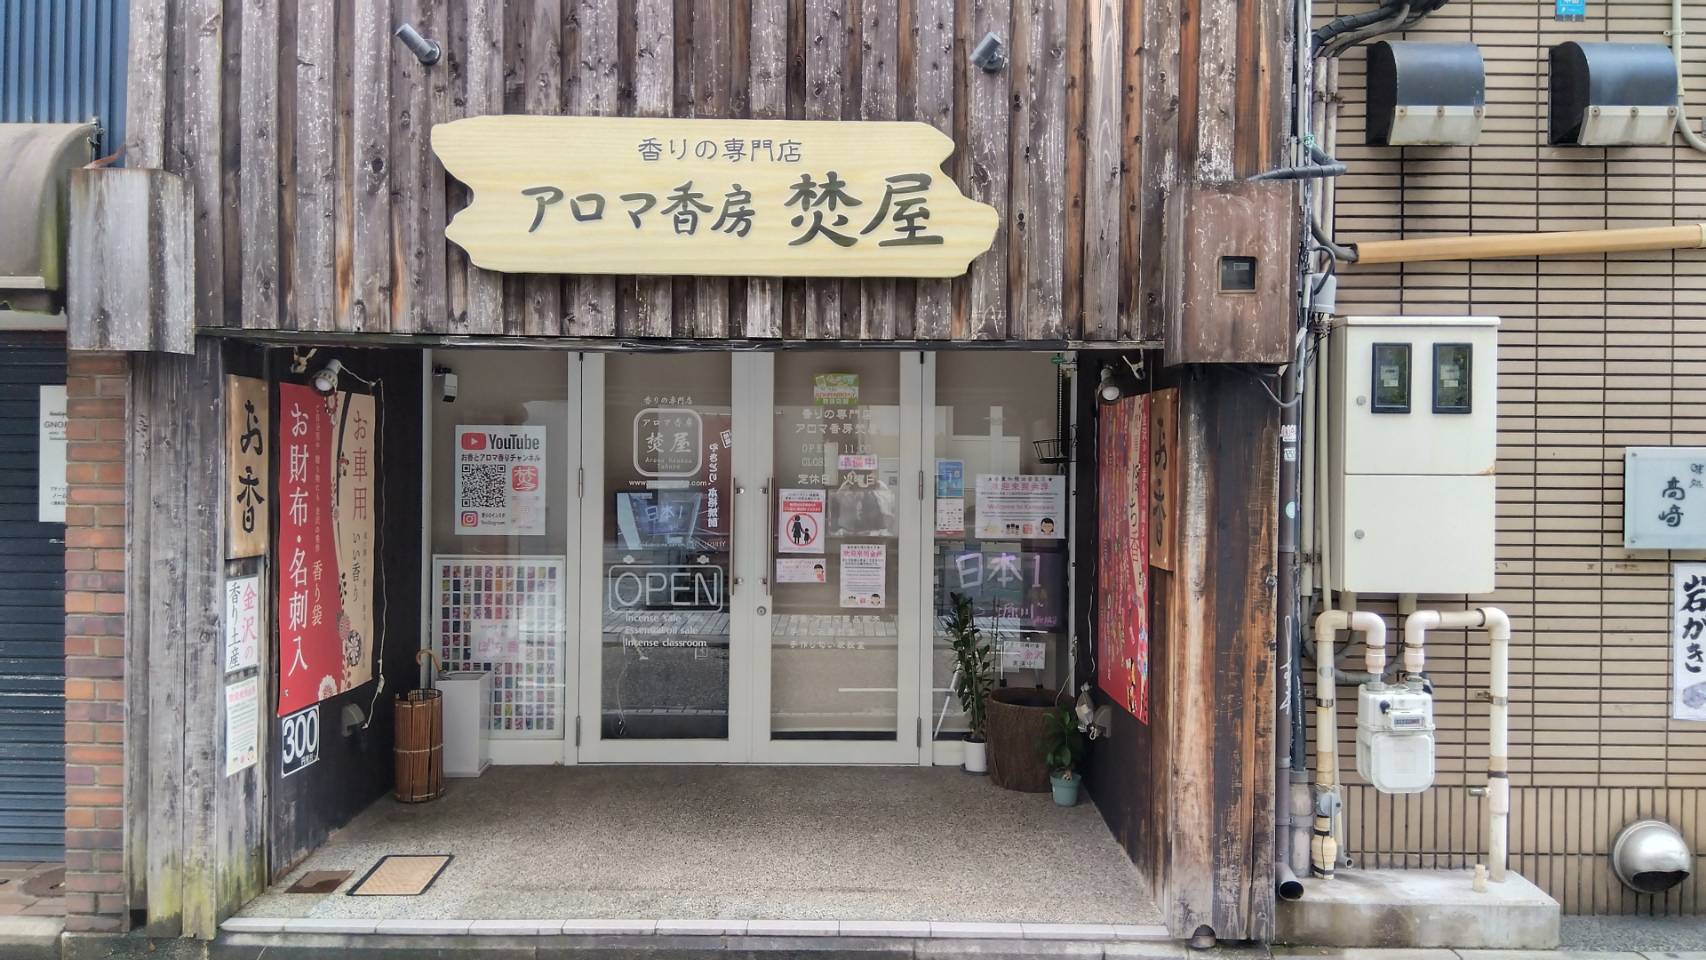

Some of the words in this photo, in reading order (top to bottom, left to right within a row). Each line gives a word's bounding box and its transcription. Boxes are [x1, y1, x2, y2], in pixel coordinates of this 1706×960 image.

[637, 138, 802, 163] 香りの専門店
[521, 181, 756, 238] アロマ香房
[784, 170, 944, 247] 焚屋
[236, 400, 265, 533] お香
[353, 410, 368, 521] お車用
[489, 434, 540, 450] YouTube
[1153, 417, 1168, 547] お香
[288, 403, 309, 677] お財布・名刺入
[228, 582, 241, 668] 香り土産
[242, 582, 257, 659] 金沢の
[312, 559, 323, 625] 香り袋
[615, 572, 717, 606] OPEN
[1680, 574, 1706, 674] 岩がき
[625, 638, 659, 647] Incense
[662, 638, 707, 647] classroom
[283, 709, 318, 764] 300
